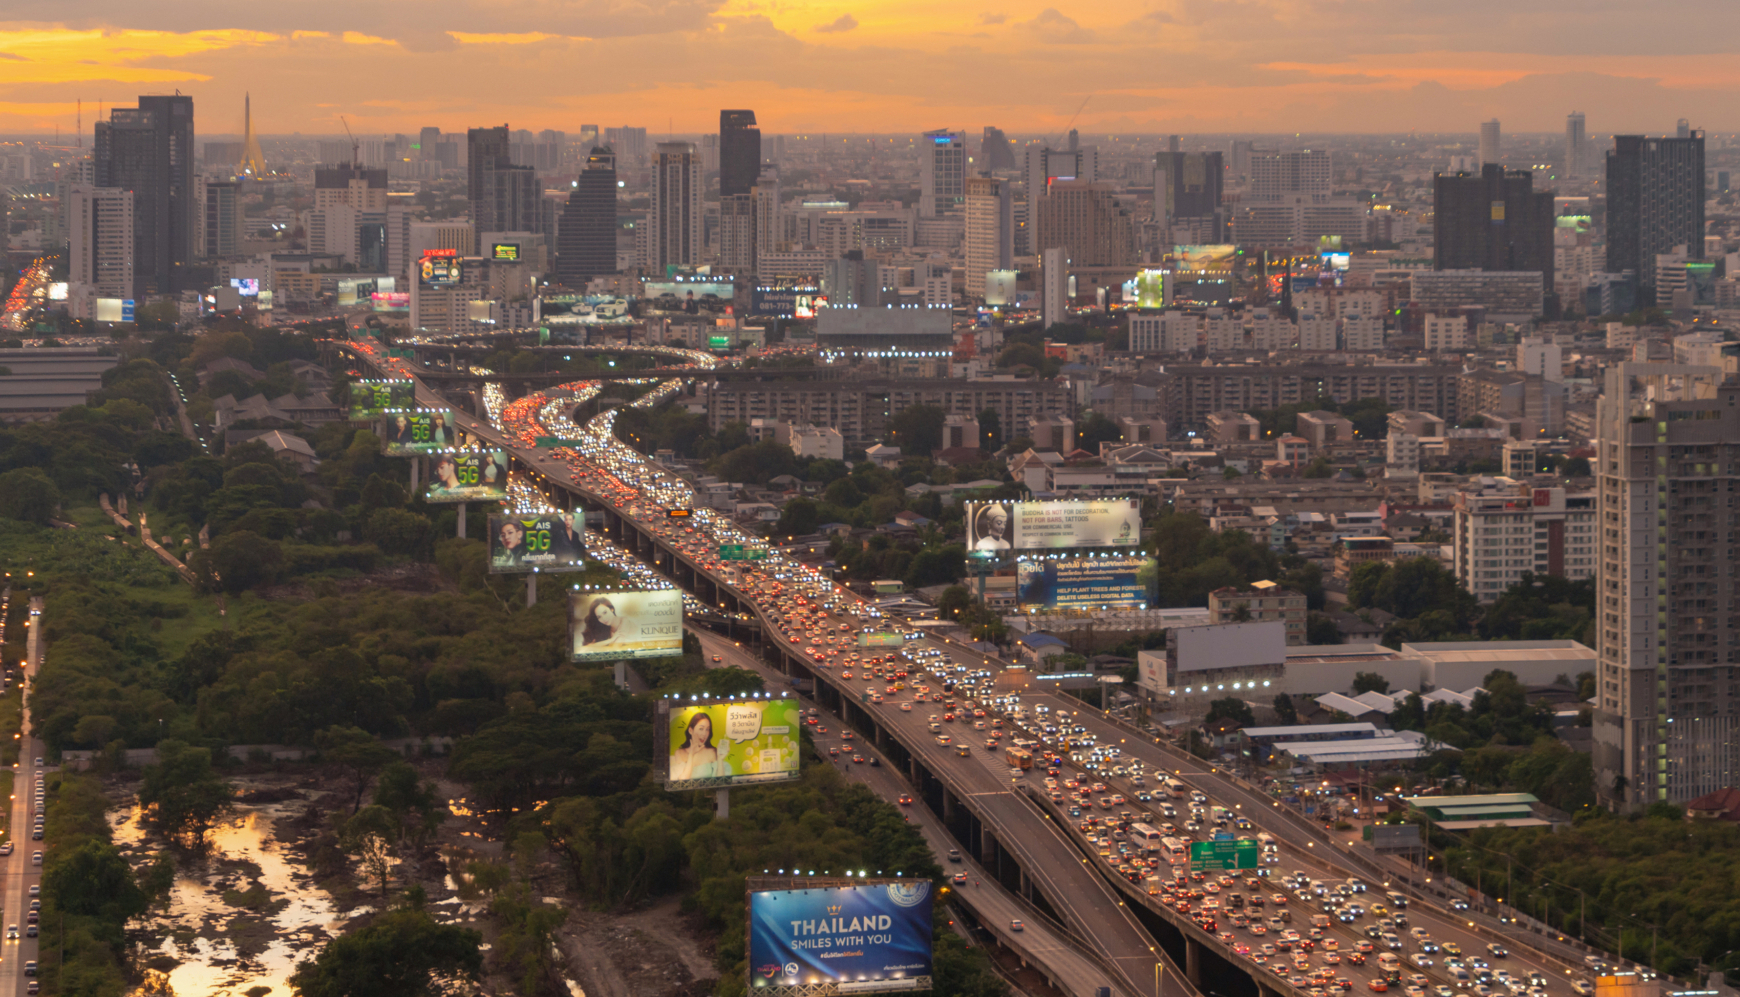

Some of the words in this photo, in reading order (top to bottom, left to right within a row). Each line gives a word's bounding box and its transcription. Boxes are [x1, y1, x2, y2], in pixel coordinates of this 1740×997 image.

[374, 392, 391, 406] 5G
[412, 424, 430, 440] 5G
[458, 466, 479, 484] 5G
[536, 522, 551, 530] AIS
[526, 530, 551, 552] 5G
[641, 626, 678, 636] KLINIQUE
[790, 915, 892, 936] THAILAND
[791, 938, 832, 950] SMILES
[835, 936, 864, 947] WITH
[867, 934, 892, 944] YOU
